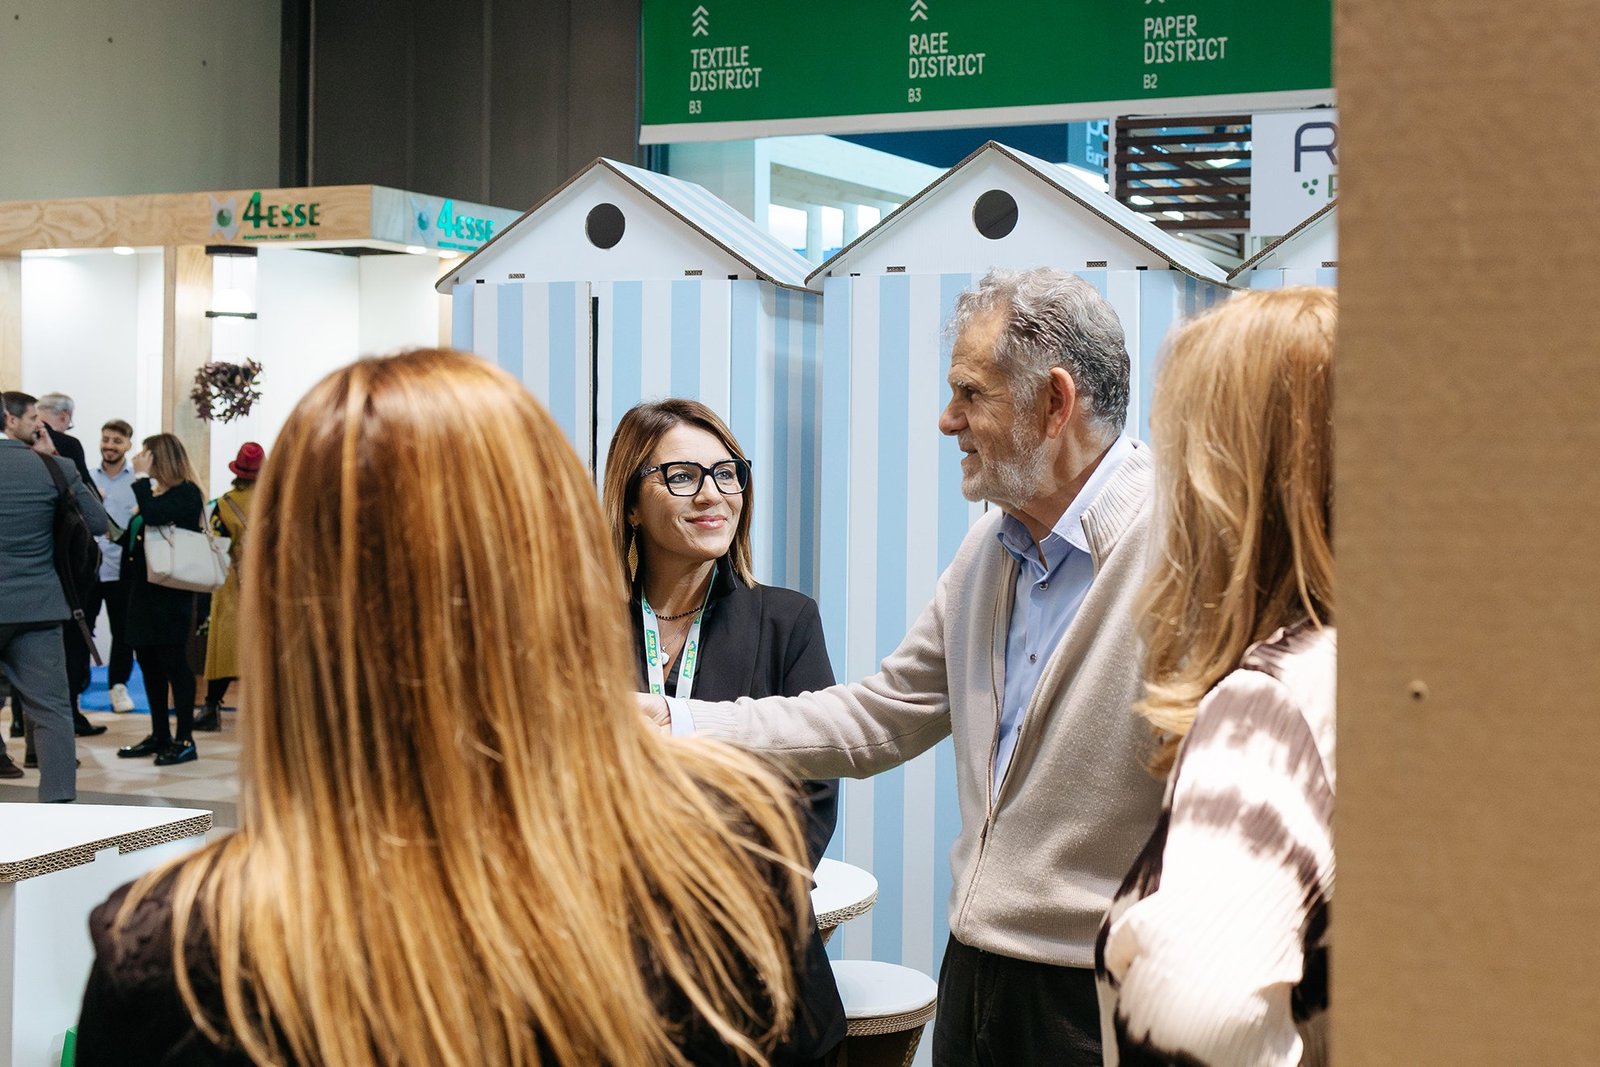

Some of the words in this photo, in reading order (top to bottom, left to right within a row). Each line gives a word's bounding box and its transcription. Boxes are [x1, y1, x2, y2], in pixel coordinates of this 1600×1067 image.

[1144, 15, 1197, 40] PAPER
[909, 32, 949, 56] RAEE
[1143, 37, 1228, 64] DISTRICT
[690, 46, 749, 69] TEXTILE
[908, 53, 985, 79] DISTRICT
[689, 67, 762, 92] DISTRICT
[1143, 73, 1158, 89] B2
[689, 100, 702, 114] B3
[907, 88, 922, 103] B3
[242, 191, 321, 228] 4ESSE
